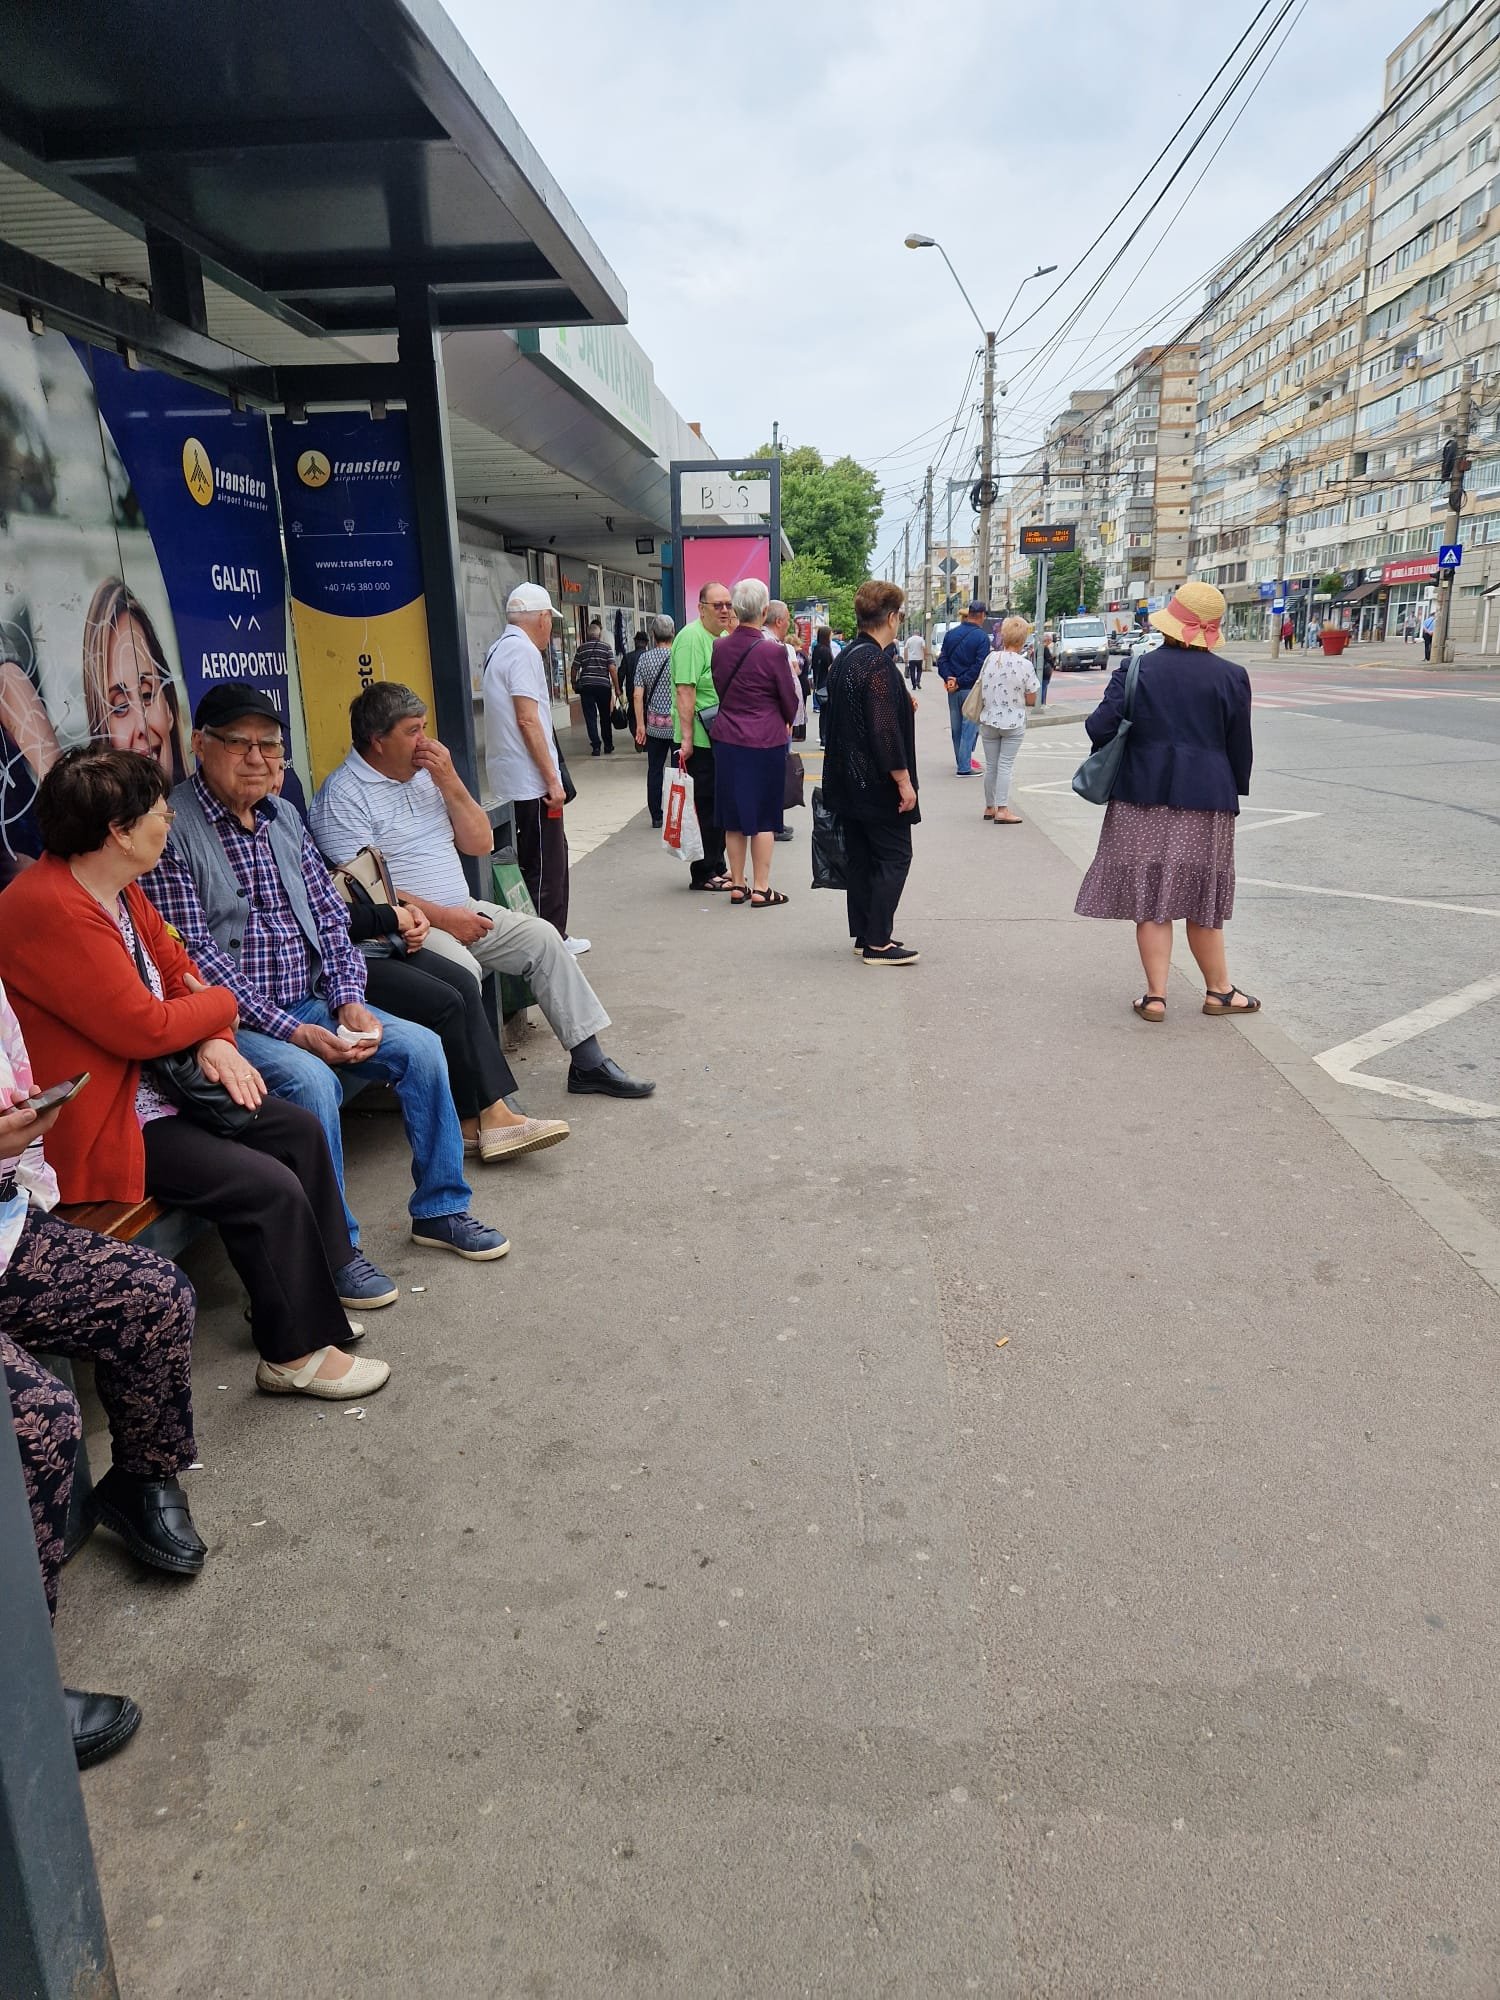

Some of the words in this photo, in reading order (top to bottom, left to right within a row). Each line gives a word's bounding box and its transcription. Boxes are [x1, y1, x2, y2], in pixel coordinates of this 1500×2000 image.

[333, 459, 401, 474] transfero
[215, 466, 266, 499] transfero
[334, 474, 364, 482] airport
[367, 473, 402, 481] transfer
[217, 492, 241, 506] airport
[243, 498, 268, 511] transfer
[701, 485, 749, 509] BUS
[315, 559, 393, 569] www.transfero.ro
[211, 564, 261, 600] GALAȚI
[324, 583, 339, 592] +40
[341, 582, 356, 592] 745
[358, 582, 373, 591] 380
[375, 582, 391, 591] 000
[202, 652, 289, 679] AEROPORTUL
